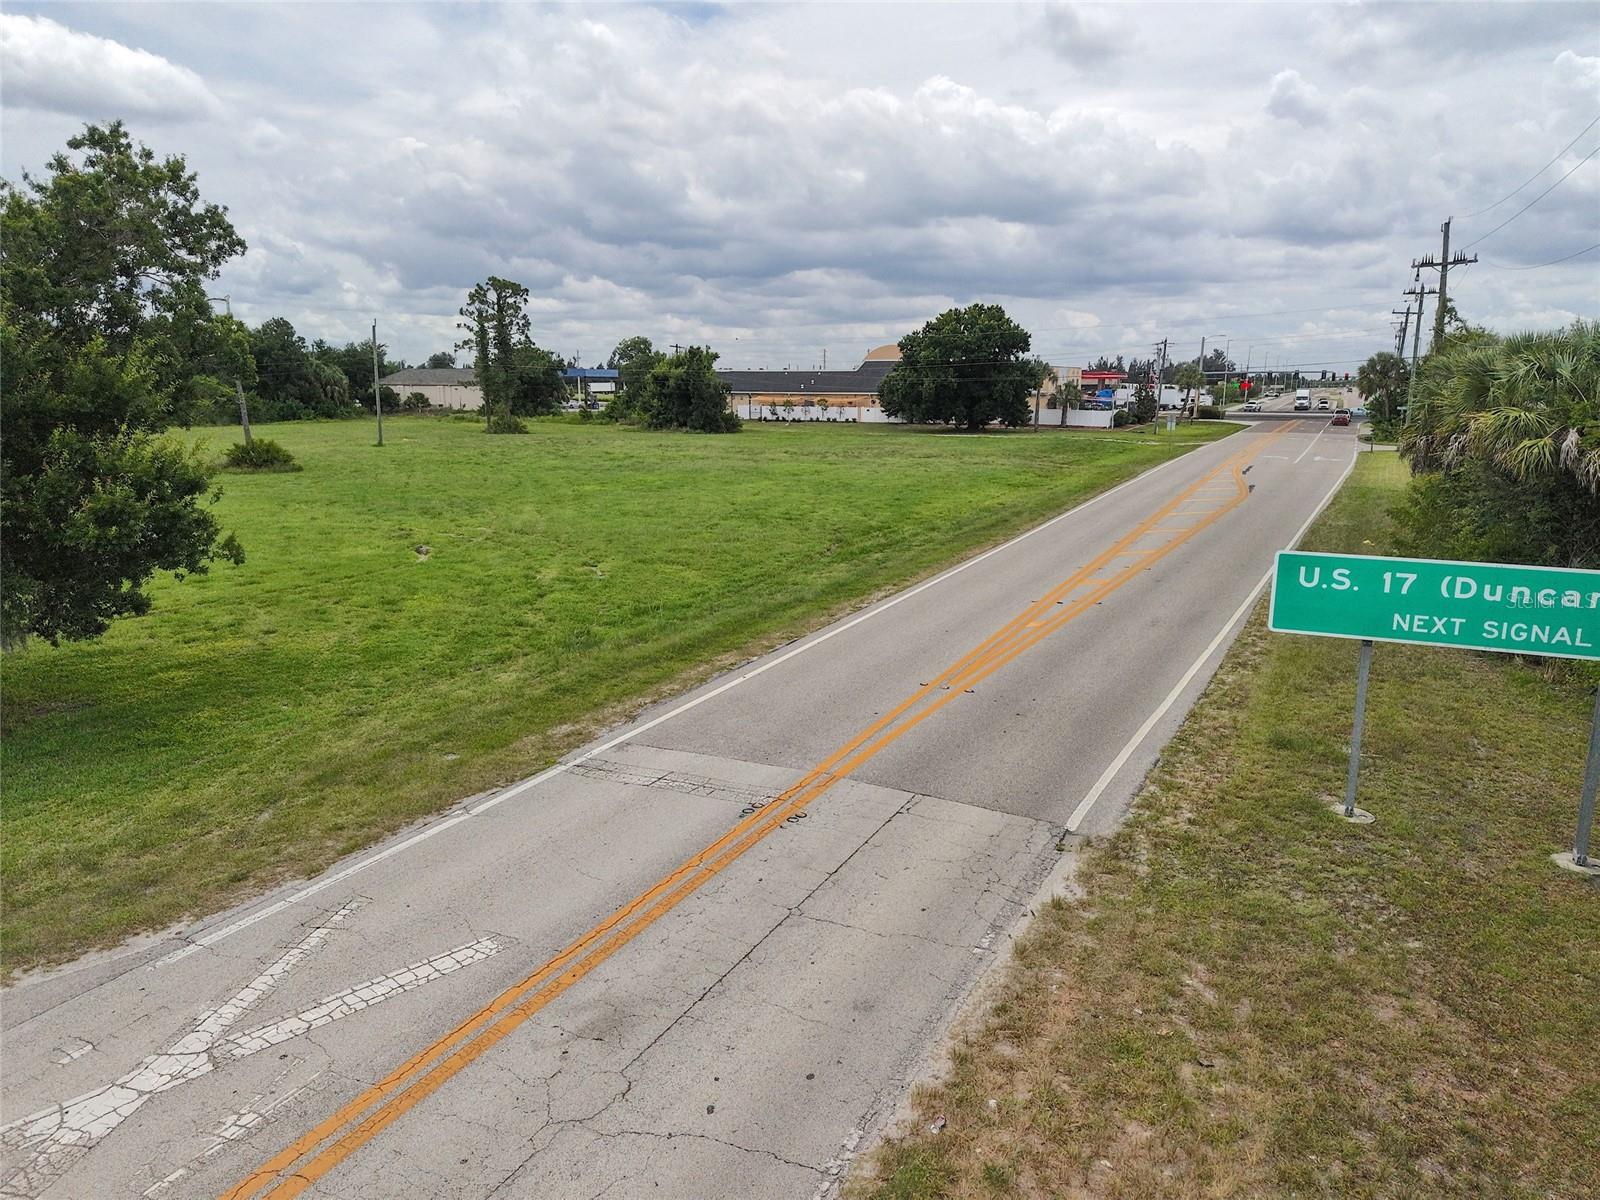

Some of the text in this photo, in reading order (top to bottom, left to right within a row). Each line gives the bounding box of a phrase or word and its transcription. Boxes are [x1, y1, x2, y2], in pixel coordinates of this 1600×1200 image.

[1299, 566, 1359, 591] U.S.
[1383, 572, 1418, 594] 17
[1392, 613, 1592, 647] NEXT SIGNAL
